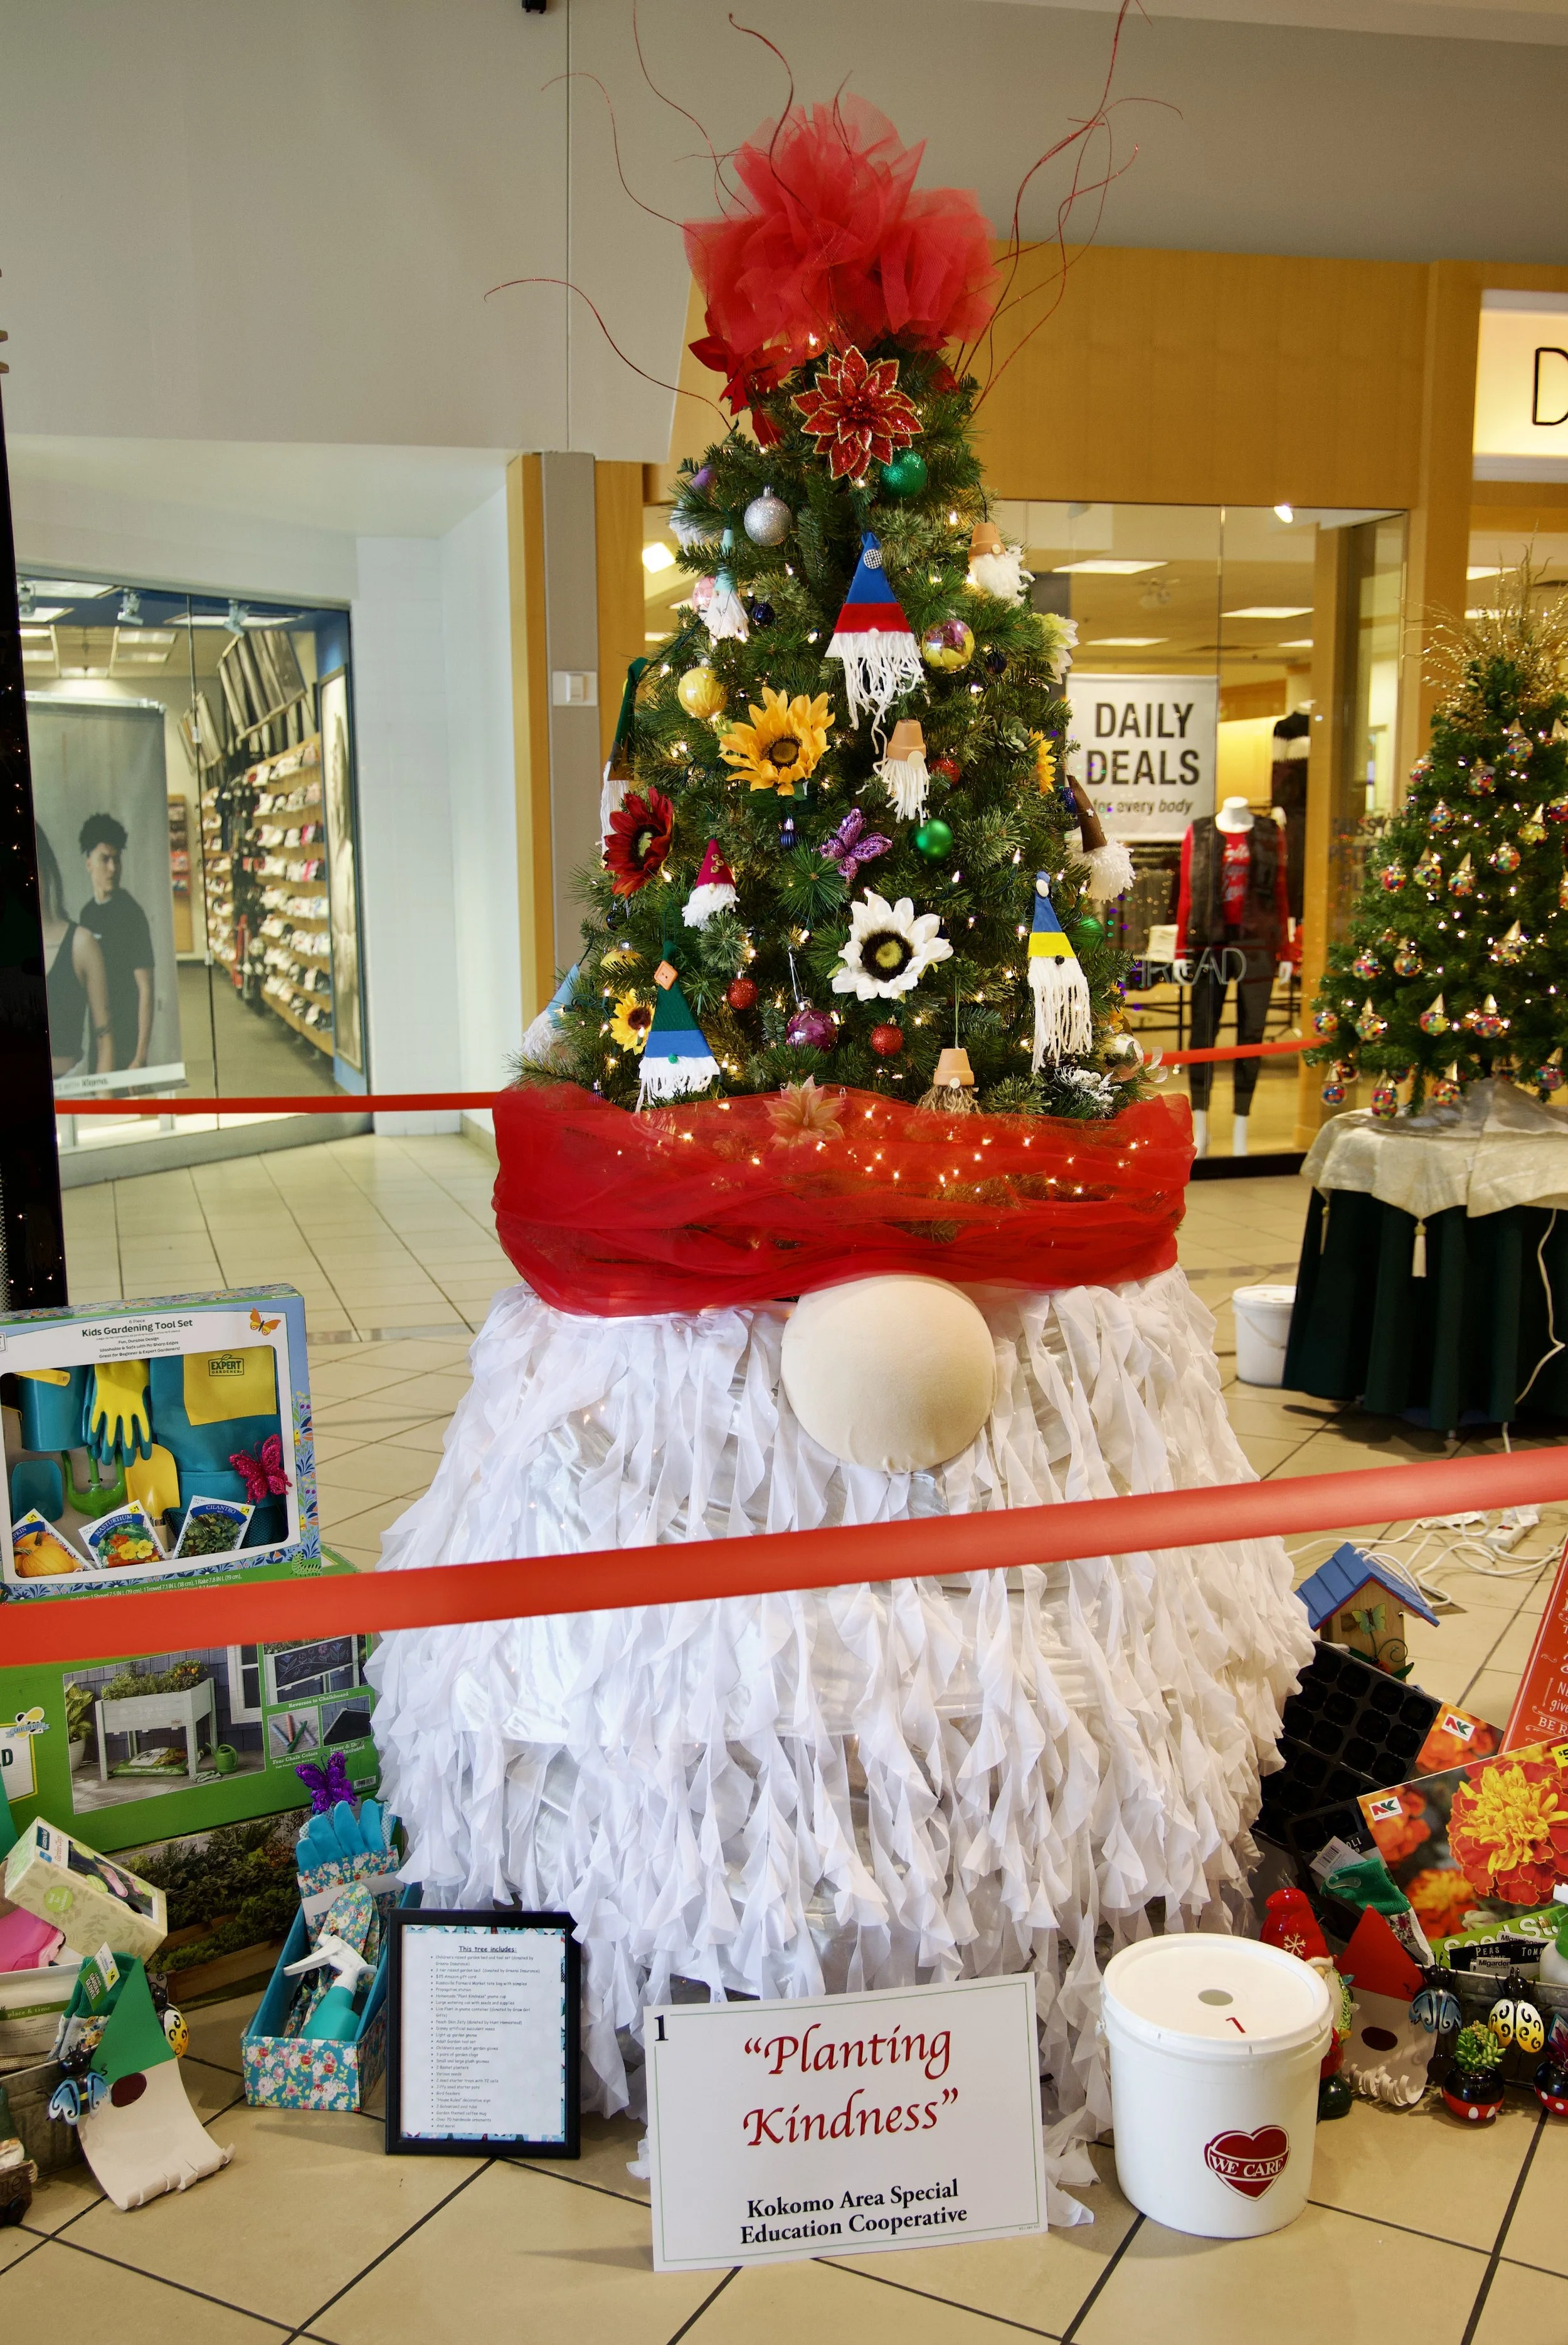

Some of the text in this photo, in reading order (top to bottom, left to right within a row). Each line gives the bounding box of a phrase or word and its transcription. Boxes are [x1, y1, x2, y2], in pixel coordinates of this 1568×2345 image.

[1094, 702, 1194, 739] DAILY
[1086, 749, 1200, 786] DEALS
[1093, 798, 1194, 816] for every body
[82, 1328, 102, 1337] Kids
[103, 1323, 154, 1335] Gardening
[155, 1321, 176, 1330] Tool
[211, 1361, 241, 1370] EXPERT
[206, 1505, 236, 1514] CILANTRO
[12, 1527, 27, 1539] PKIN
[95, 1515, 132, 1536] NASTURTIUM
[289, 1700, 312, 1708] Reverses
[319, 1691, 349, 1703] Chalkboard
[1538, 1717, 1555, 1730] BE
[343, 1745, 366, 1754] Included
[1476, 1947, 1500, 1957] PEAS
[85, 1979, 97, 1999] GLOVES
[89, 1972, 100, 1995] GARDEN
[8, 2011, 25, 2019] place
[654, 2014, 669, 2042] 1
[744, 2023, 951, 2080] “Planting
[743, 2087, 959, 2146] Kindness”
[1210, 2154, 1285, 2179] WE CARE
[747, 2178, 959, 2219] Kokomo Area Special
[740, 2206, 968, 2245] Education Cooperative
